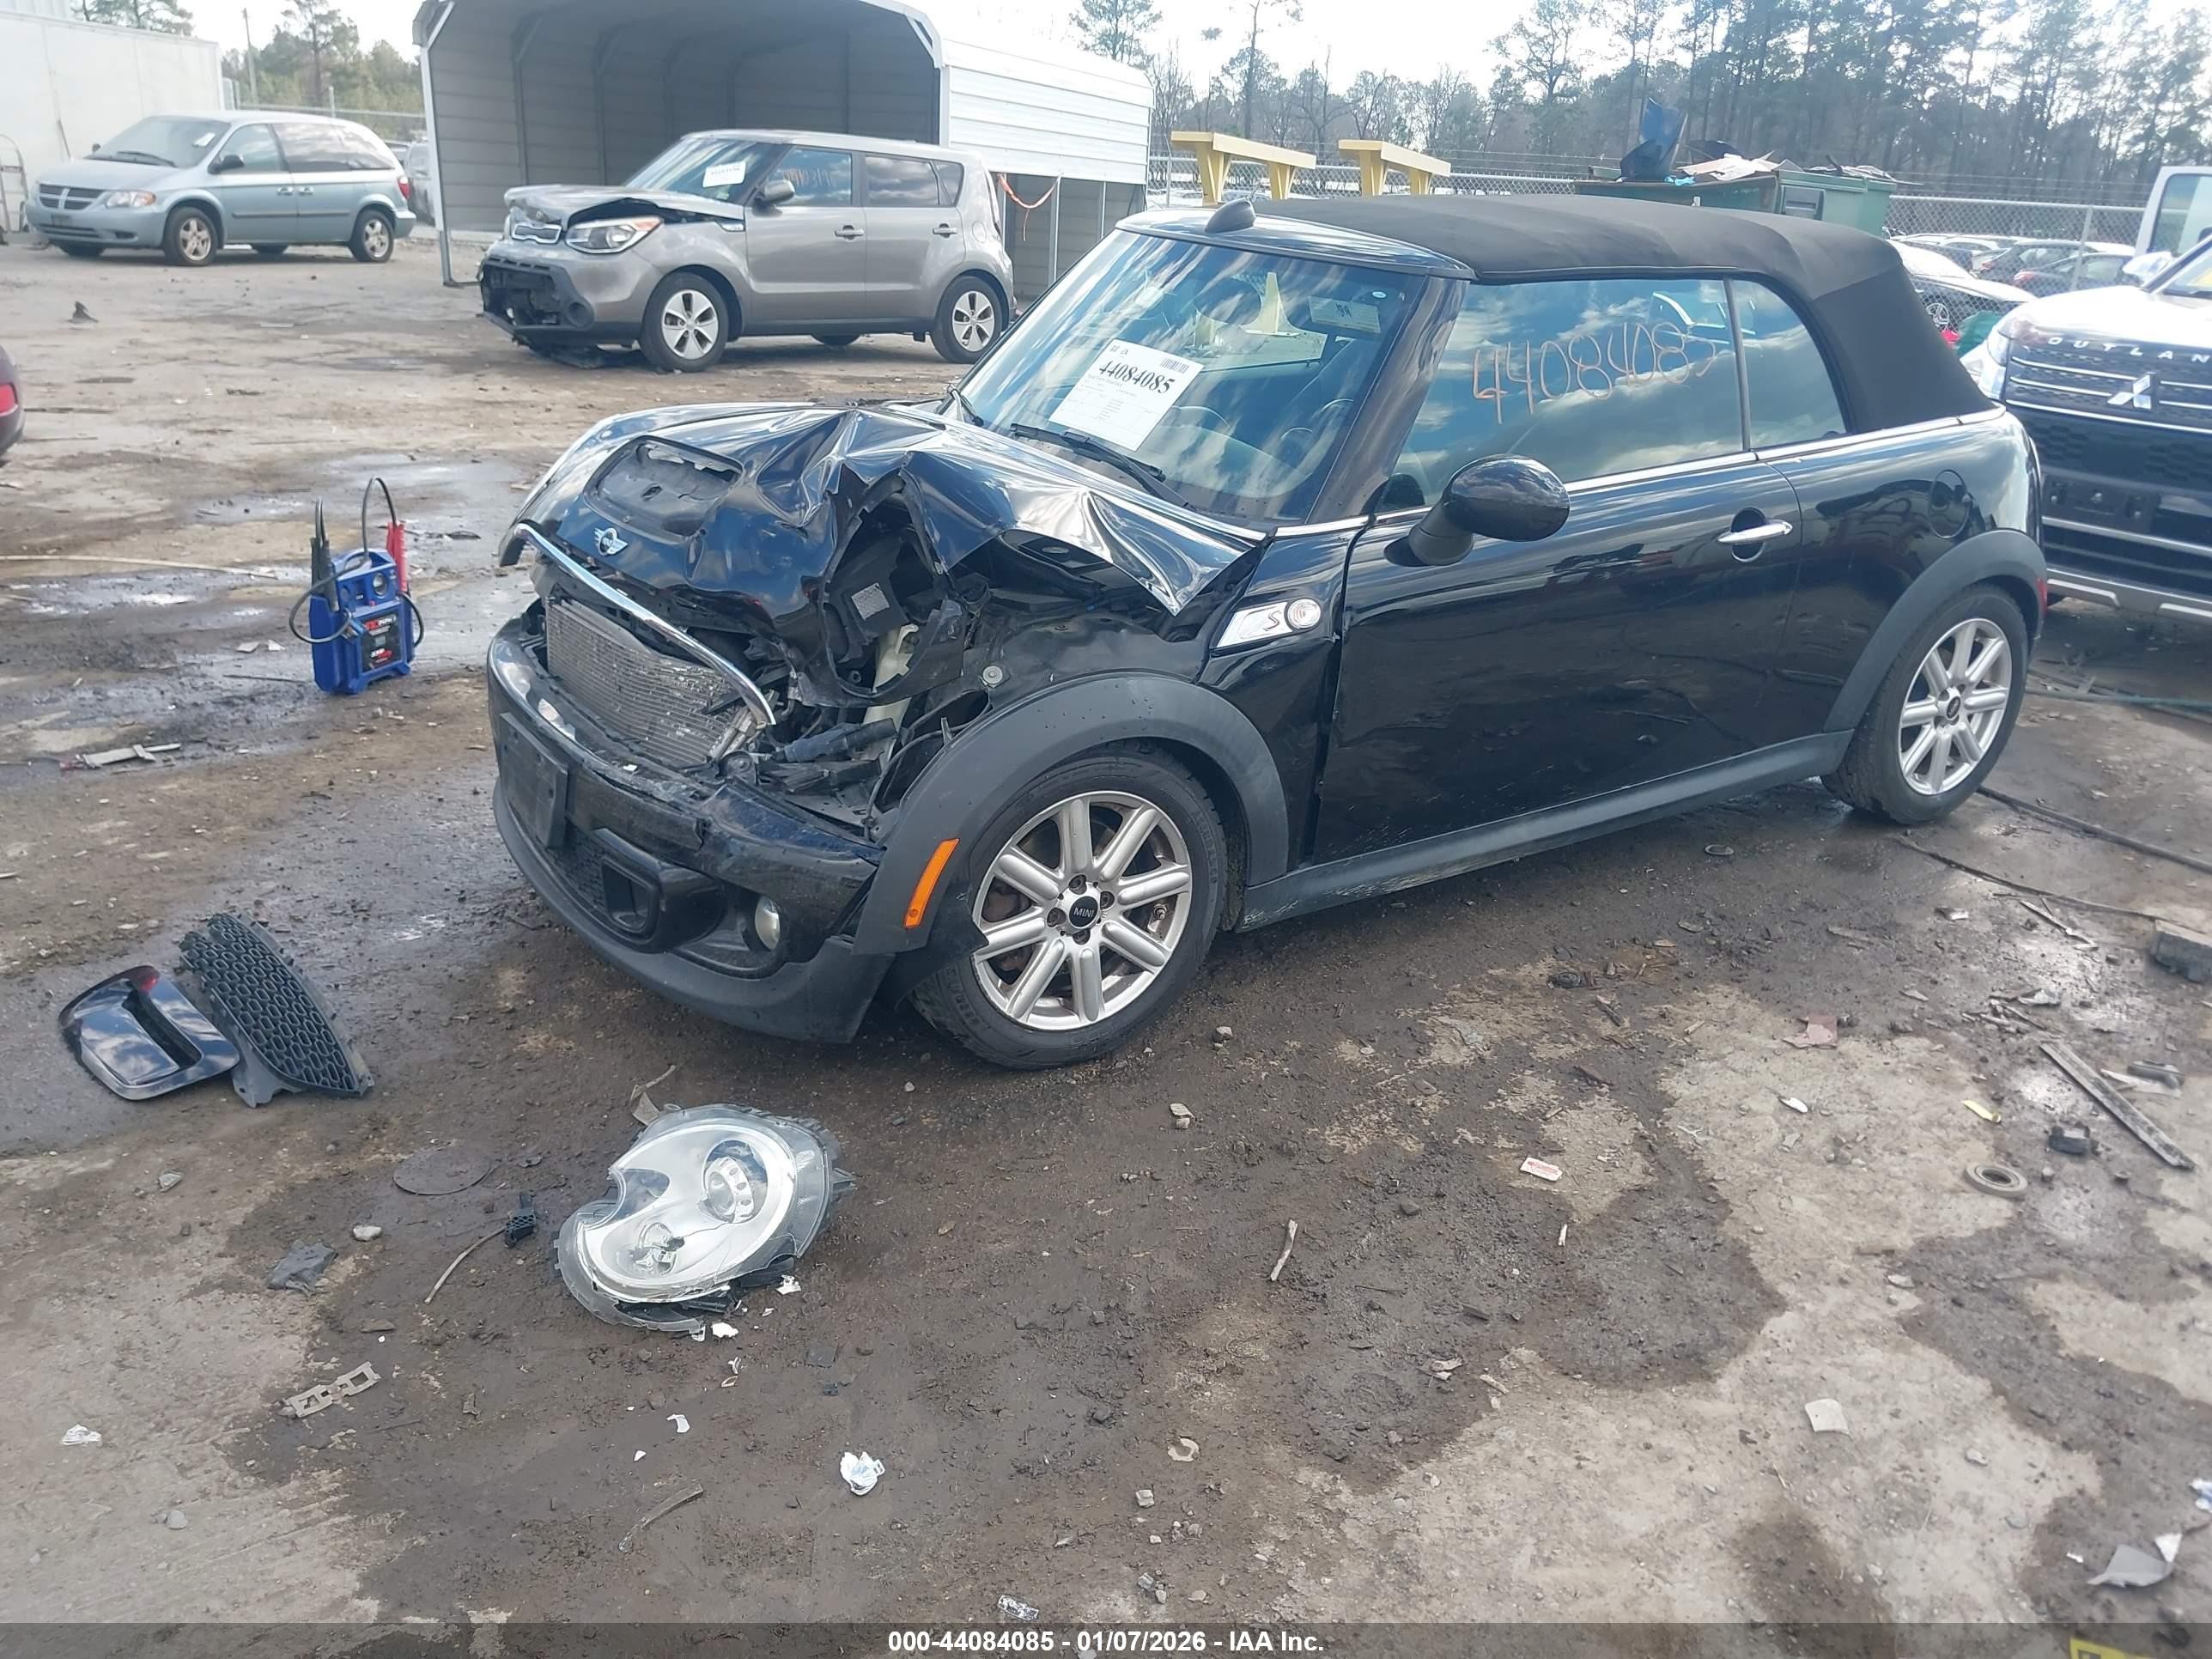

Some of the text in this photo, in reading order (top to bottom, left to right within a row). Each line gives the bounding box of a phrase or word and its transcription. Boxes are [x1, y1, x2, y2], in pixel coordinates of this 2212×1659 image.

[1098, 360, 1176, 394] 44084085
[1263, 610, 1282, 631] S
[1073, 907, 1095, 918] MINI
